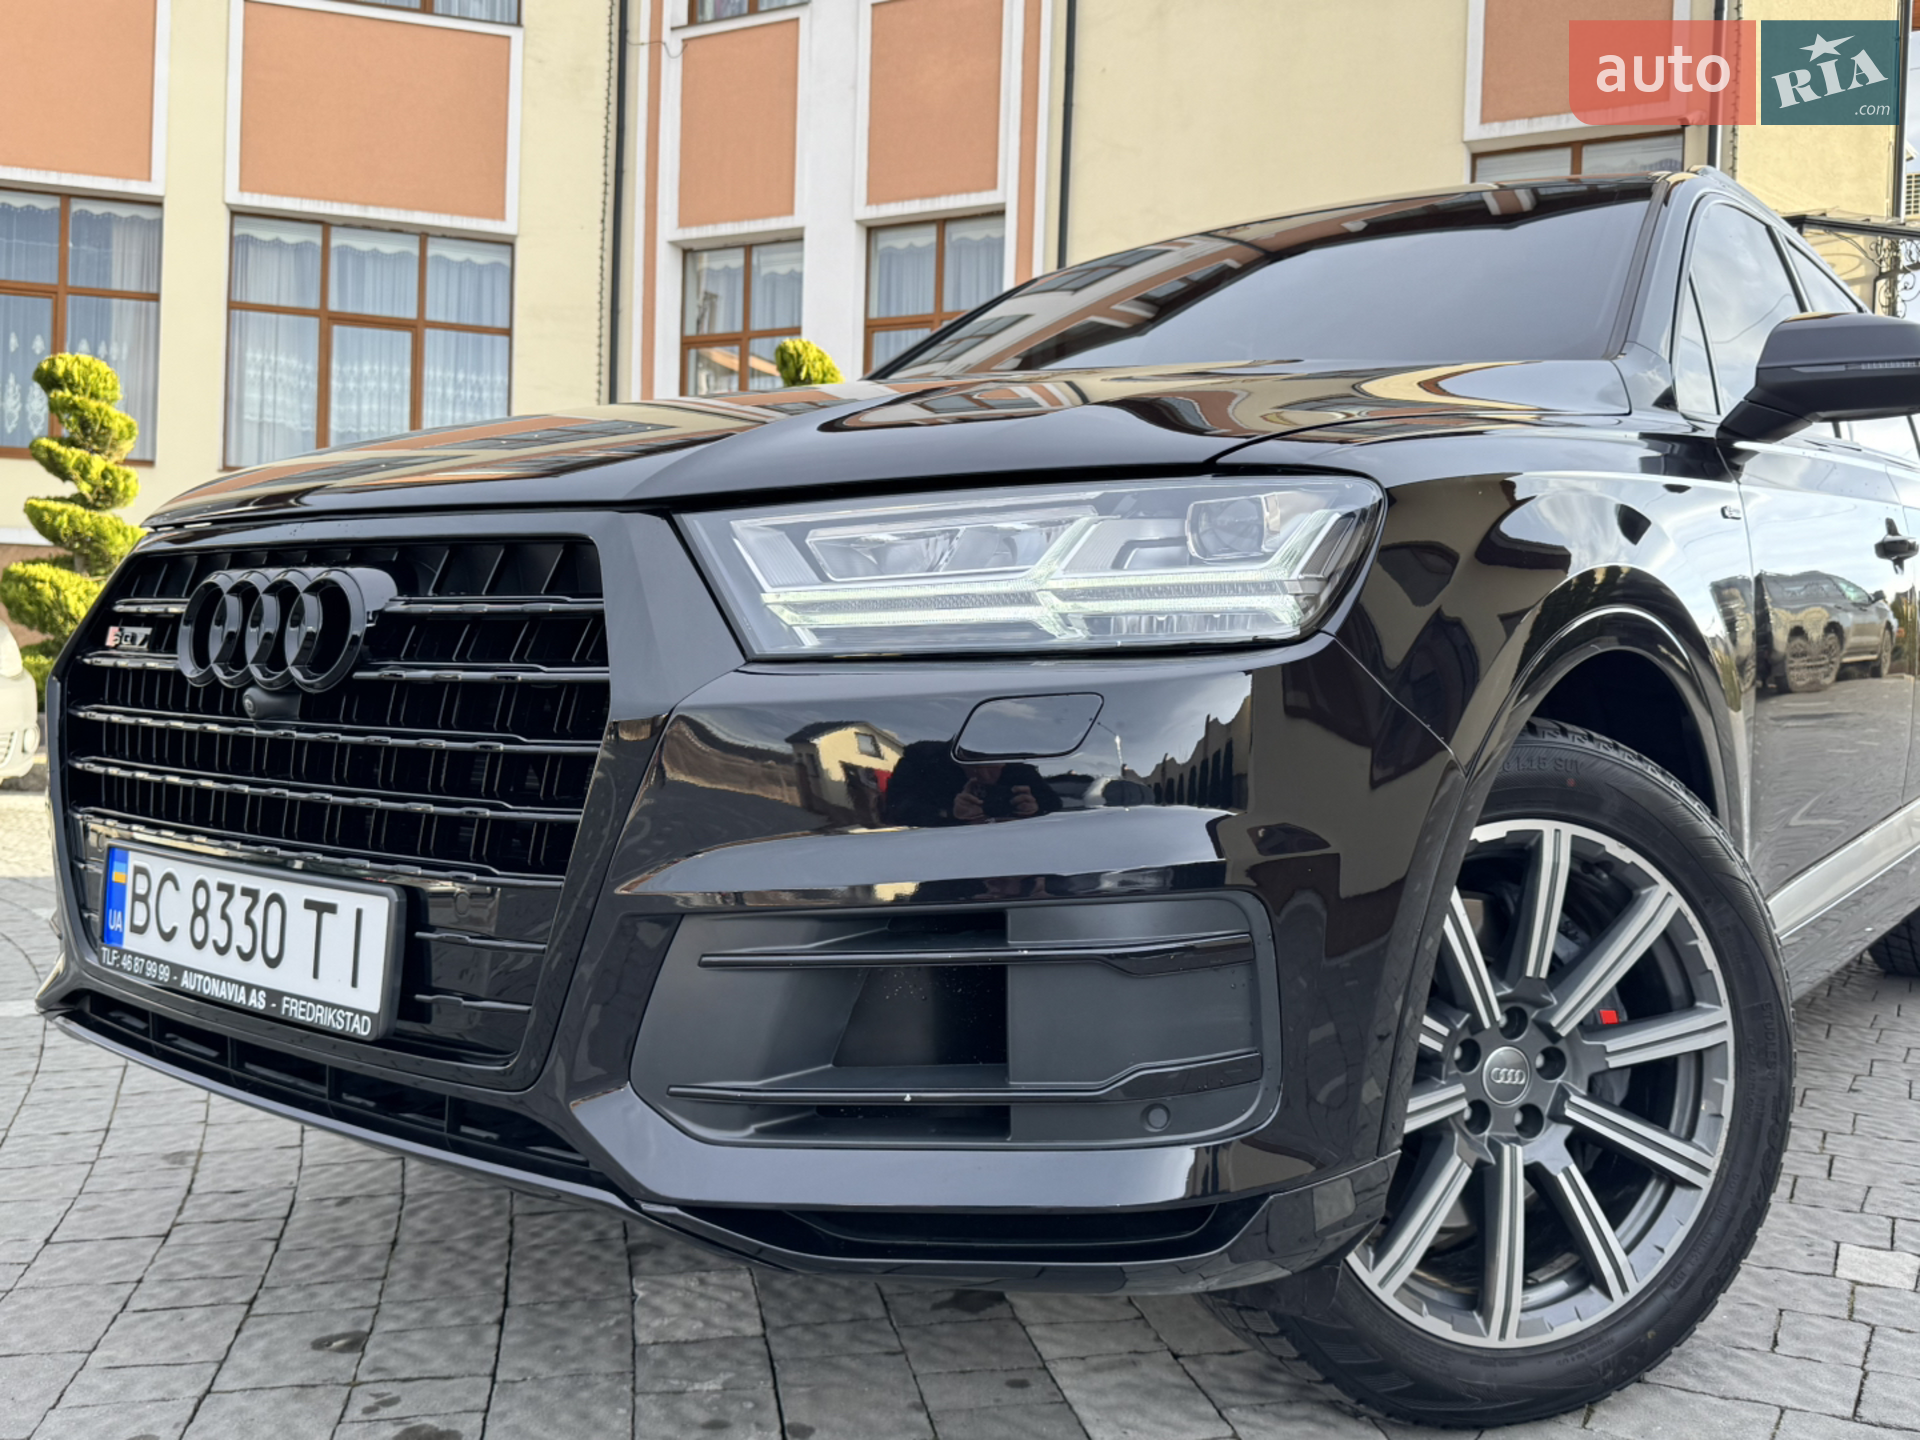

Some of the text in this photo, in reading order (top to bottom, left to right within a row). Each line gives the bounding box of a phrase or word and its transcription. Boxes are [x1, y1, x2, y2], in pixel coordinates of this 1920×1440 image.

[108, 909, 123, 932] UA
[129, 864, 364, 989] BC 8330 TI
[101, 946, 120, 968] TLF:
[121, 953, 133, 971] 46
[133, 956, 145, 974] 87
[145, 959, 158, 979] 99
[158, 963, 171, 983] 99
[181, 970, 246, 1004] AUTONAVIA
[247, 988, 266, 1011] AS
[281, 996, 372, 1036] FREDRIKSTAD
